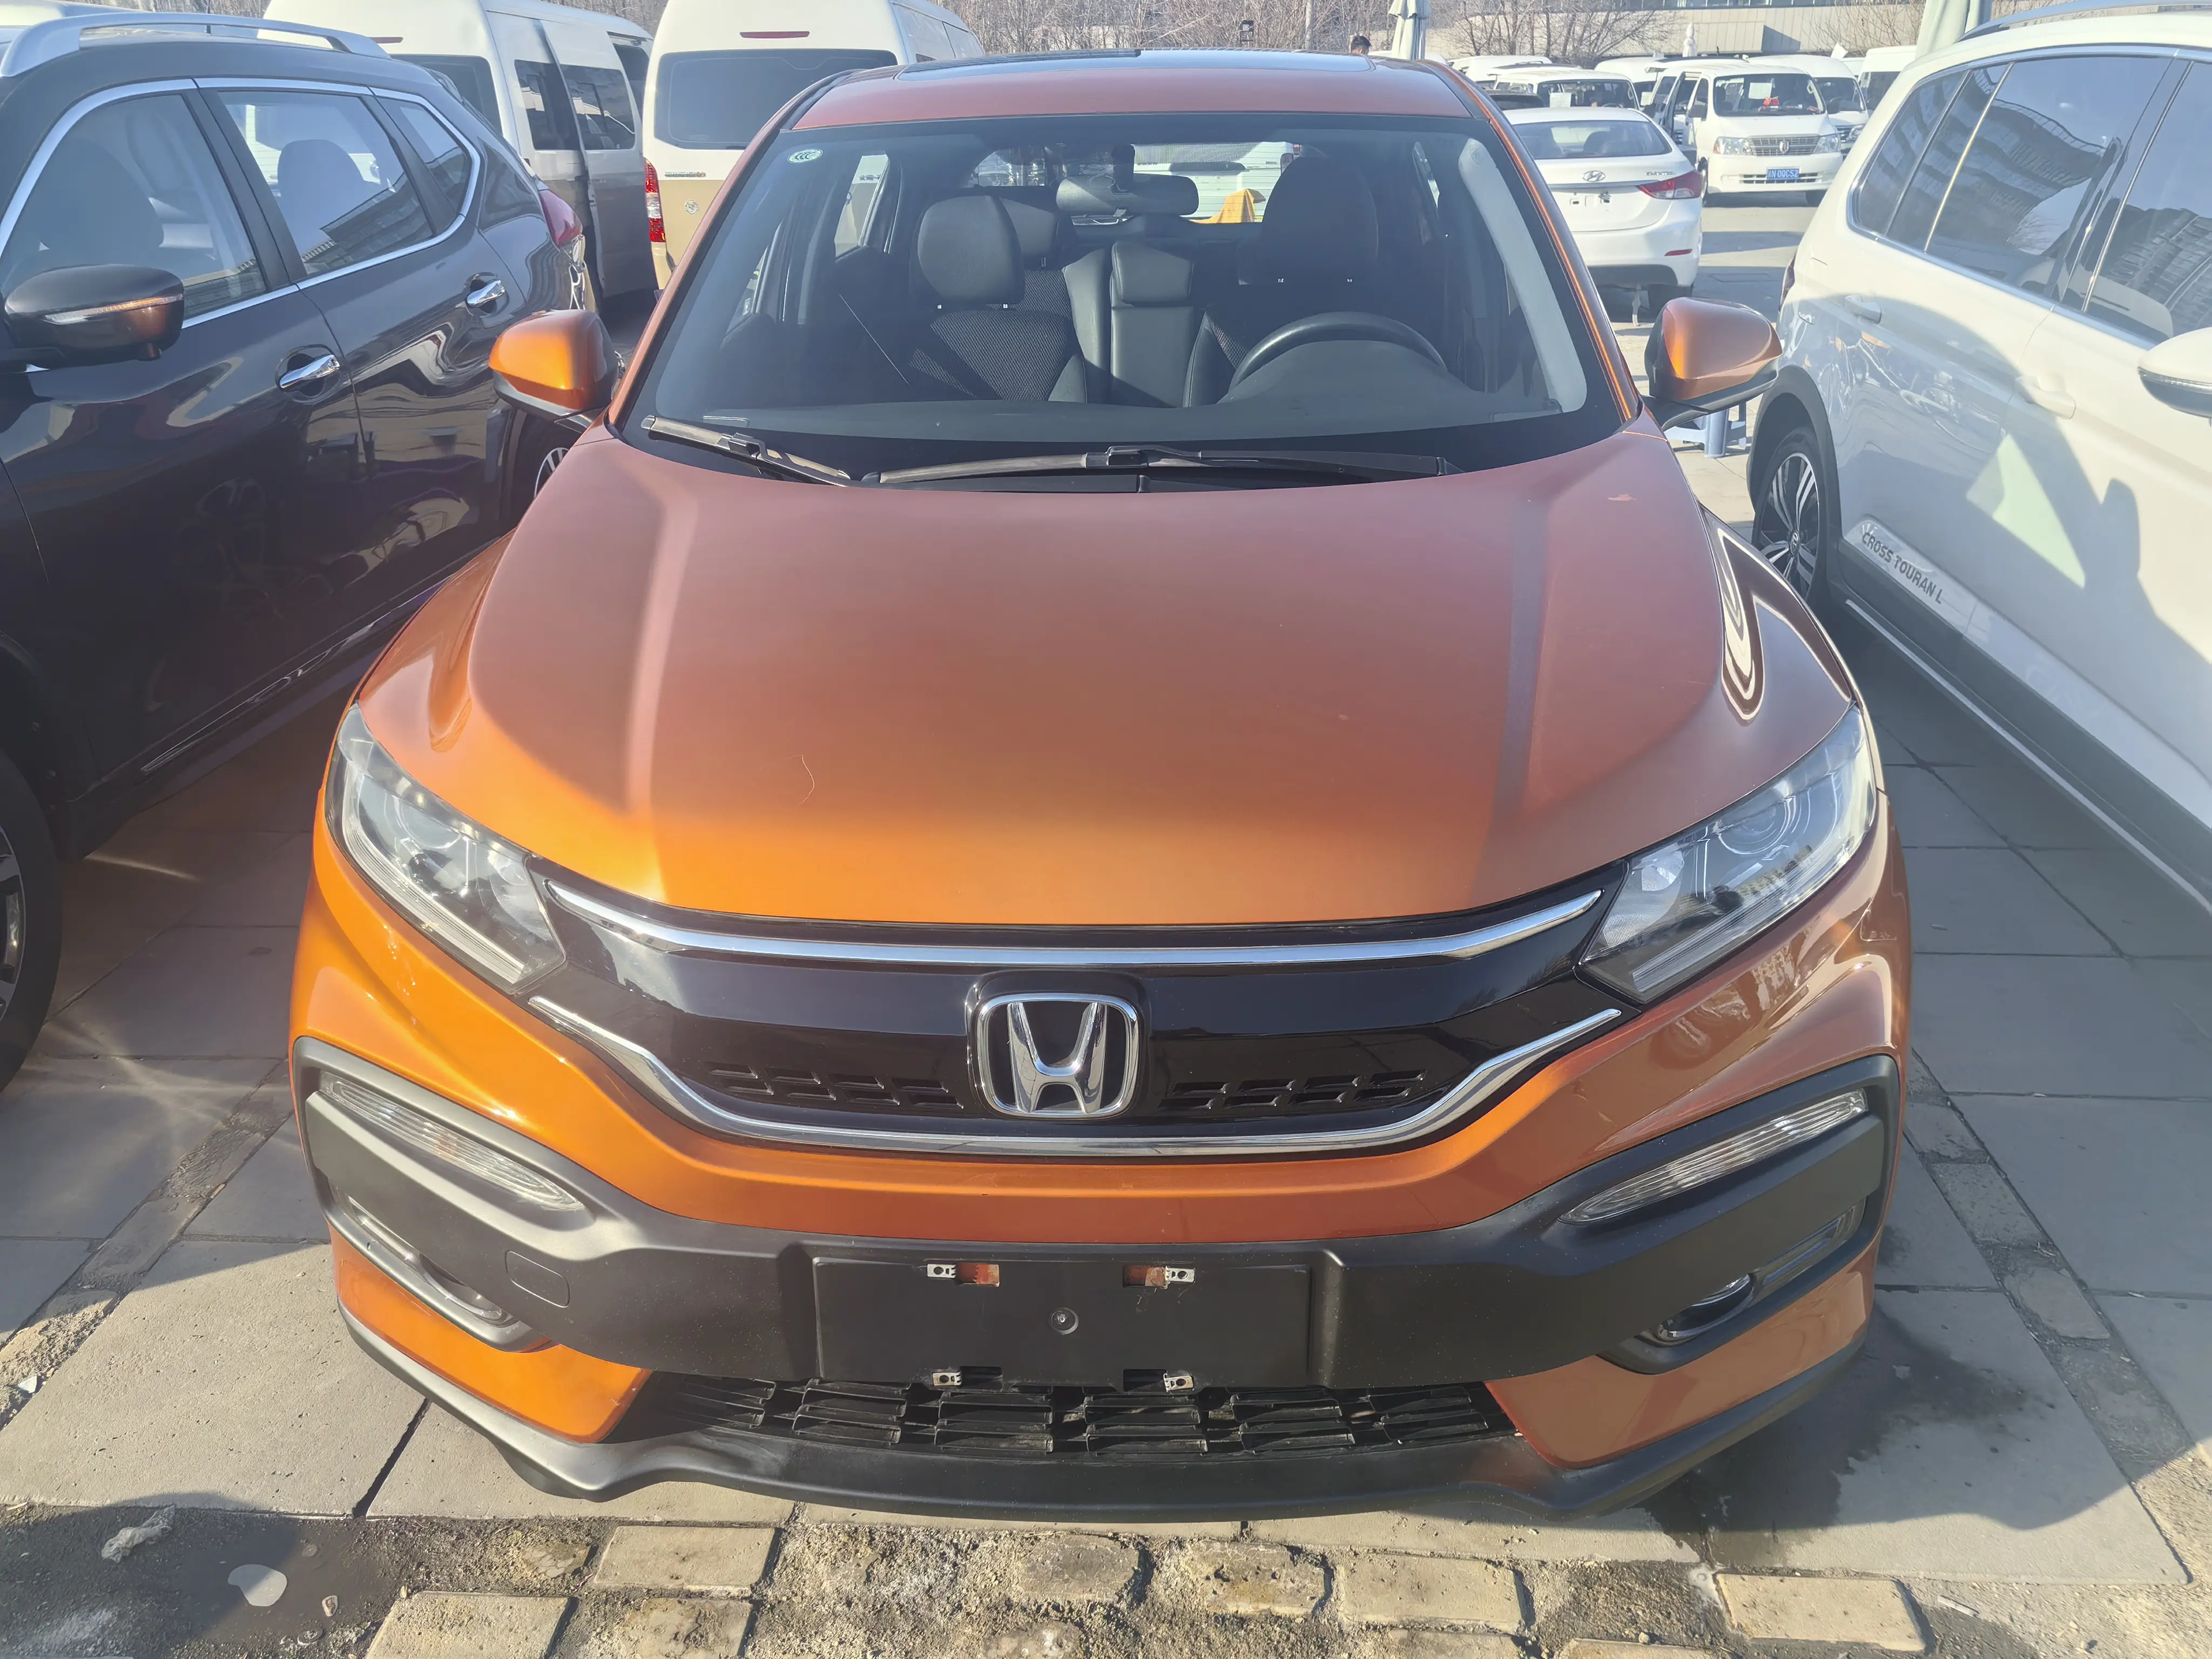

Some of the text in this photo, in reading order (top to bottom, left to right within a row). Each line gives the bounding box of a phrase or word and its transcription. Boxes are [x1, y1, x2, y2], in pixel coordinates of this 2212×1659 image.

[1862, 532, 1943, 604] CROSS TOURAN L
